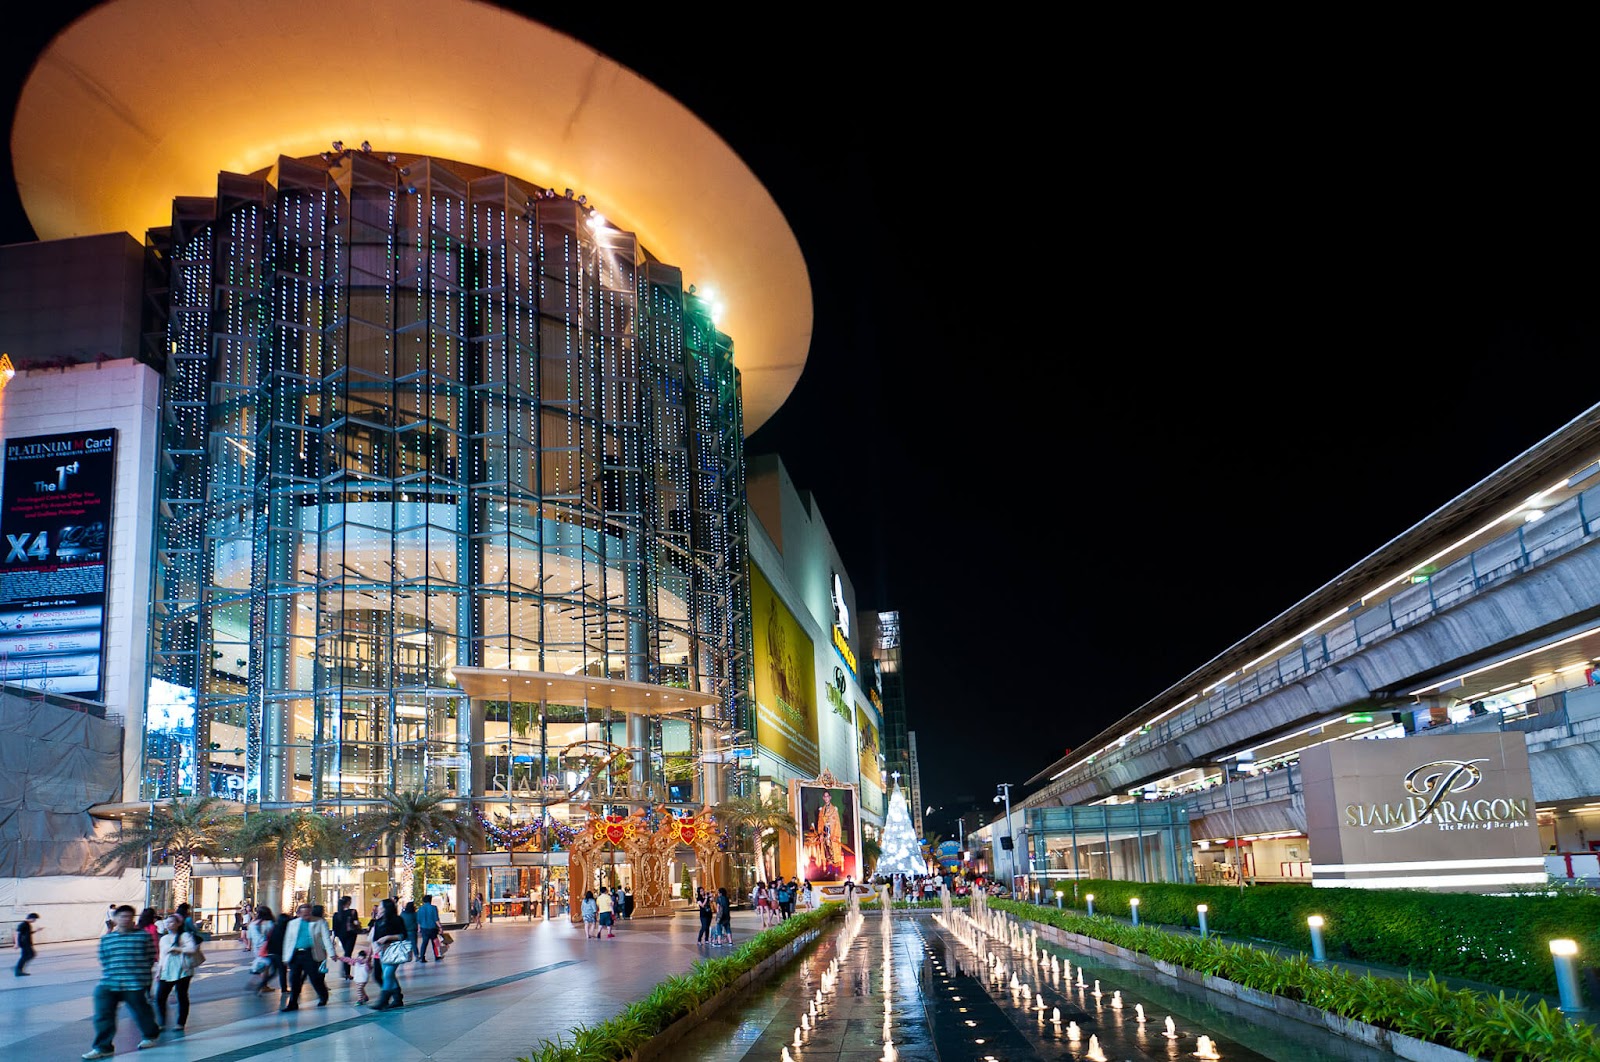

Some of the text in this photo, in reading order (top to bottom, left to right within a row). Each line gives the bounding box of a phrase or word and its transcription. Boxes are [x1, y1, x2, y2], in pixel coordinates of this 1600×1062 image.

[8, 441, 72, 456] PLATINUM
[85, 436, 112, 448] Card
[34, 481, 56, 492] The
[5, 531, 50, 563] X4
[493, 771, 670, 802] SIAM PARAGON
[1345, 796, 1529, 827] SIAM PARAGON
[1438, 822, 1454, 831] The
[1456, 821, 1479, 830] Pride
[1482, 820, 1492, 830] of
